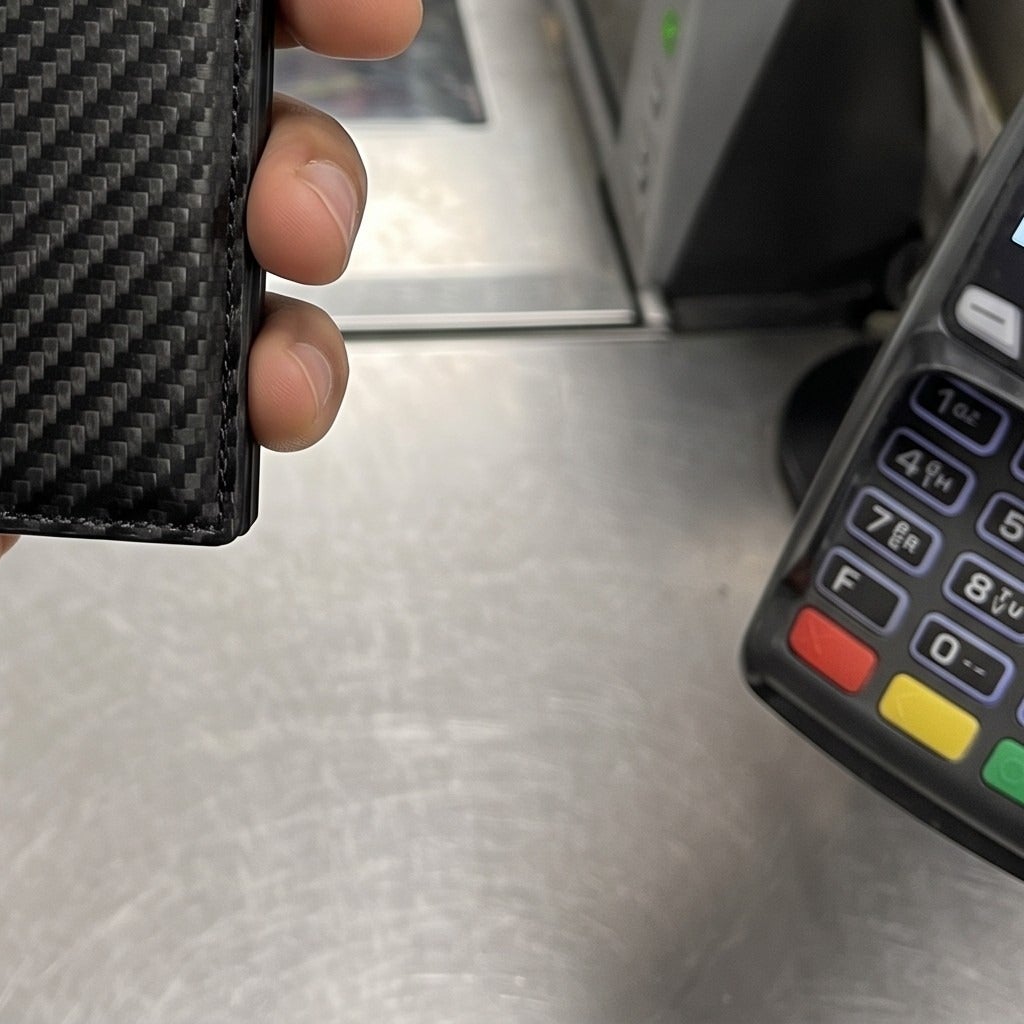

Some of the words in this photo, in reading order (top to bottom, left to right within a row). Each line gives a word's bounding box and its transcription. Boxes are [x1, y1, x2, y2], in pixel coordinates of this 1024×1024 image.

[938, 388, 955, 414] 1
[895, 449, 923, 476] 4
[866, 504, 893, 533] 7
[998, 509, 1024, 542] 5
[831, 565, 862, 592] F
[964, 572, 994, 604] 8
[929, 633, 961, 666] 0
